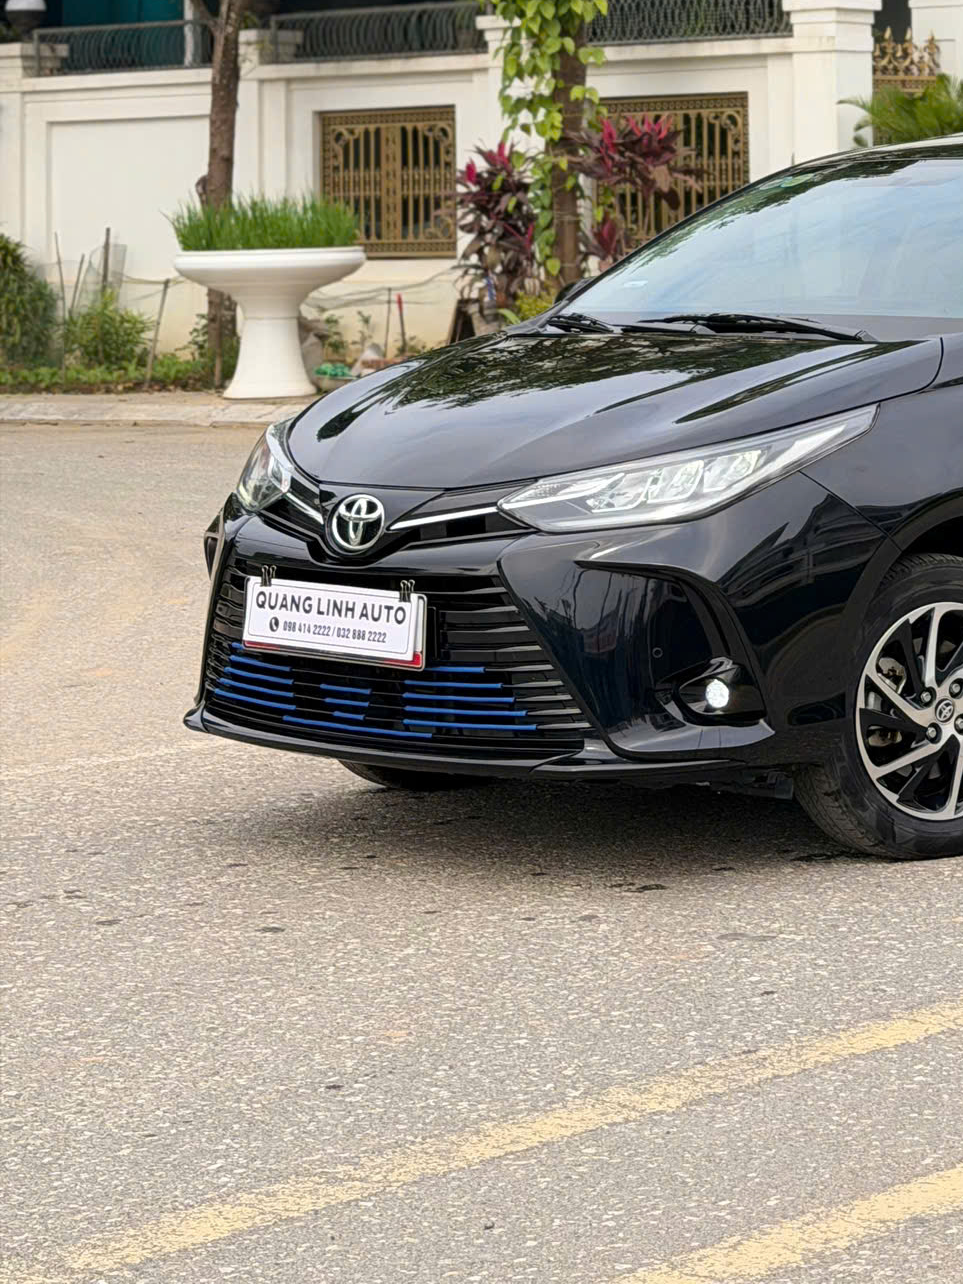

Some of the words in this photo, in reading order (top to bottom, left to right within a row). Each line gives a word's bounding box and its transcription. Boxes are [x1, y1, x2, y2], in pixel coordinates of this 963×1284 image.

[256, 591, 313, 614] QUANG
[316, 597, 355, 619] LINH
[359, 602, 406, 625] AUTO
[283, 620, 297, 632] 098
[298, 622, 311, 634] 414
[312, 623, 331, 637] 2222
[336, 627, 351, 639] 032
[367, 630, 387, 643] 2222
